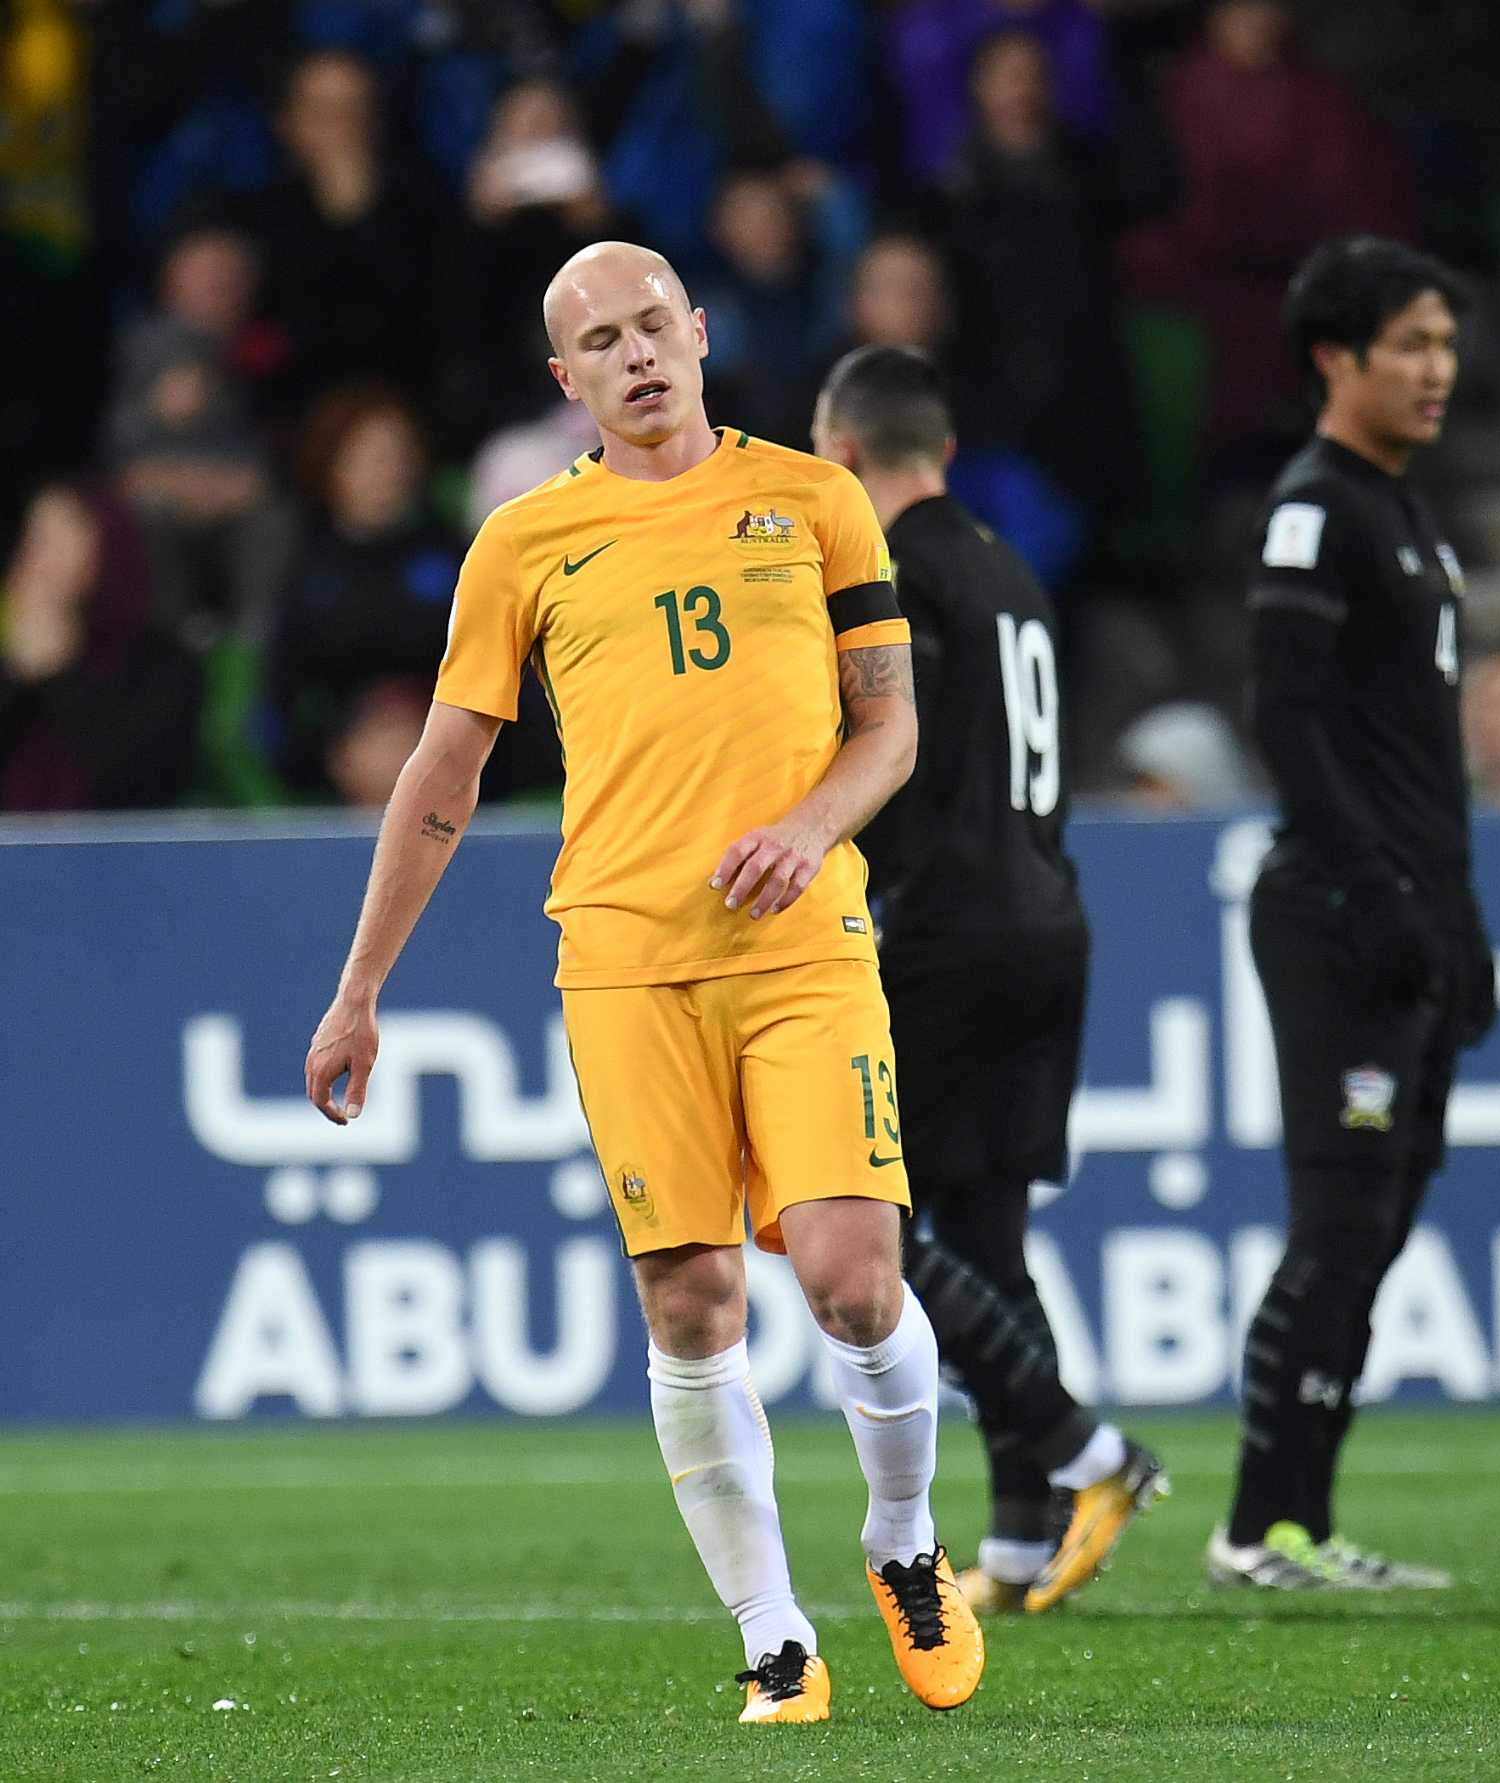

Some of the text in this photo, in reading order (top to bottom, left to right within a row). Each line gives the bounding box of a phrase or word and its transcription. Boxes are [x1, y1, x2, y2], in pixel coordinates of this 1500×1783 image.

[655, 585, 731, 676] 13
[996, 611, 1060, 817] 19
[851, 1054, 899, 1145] 13
[196, 1235, 621, 1420] ABU
[743, 1228, 1290, 1408] DBI
